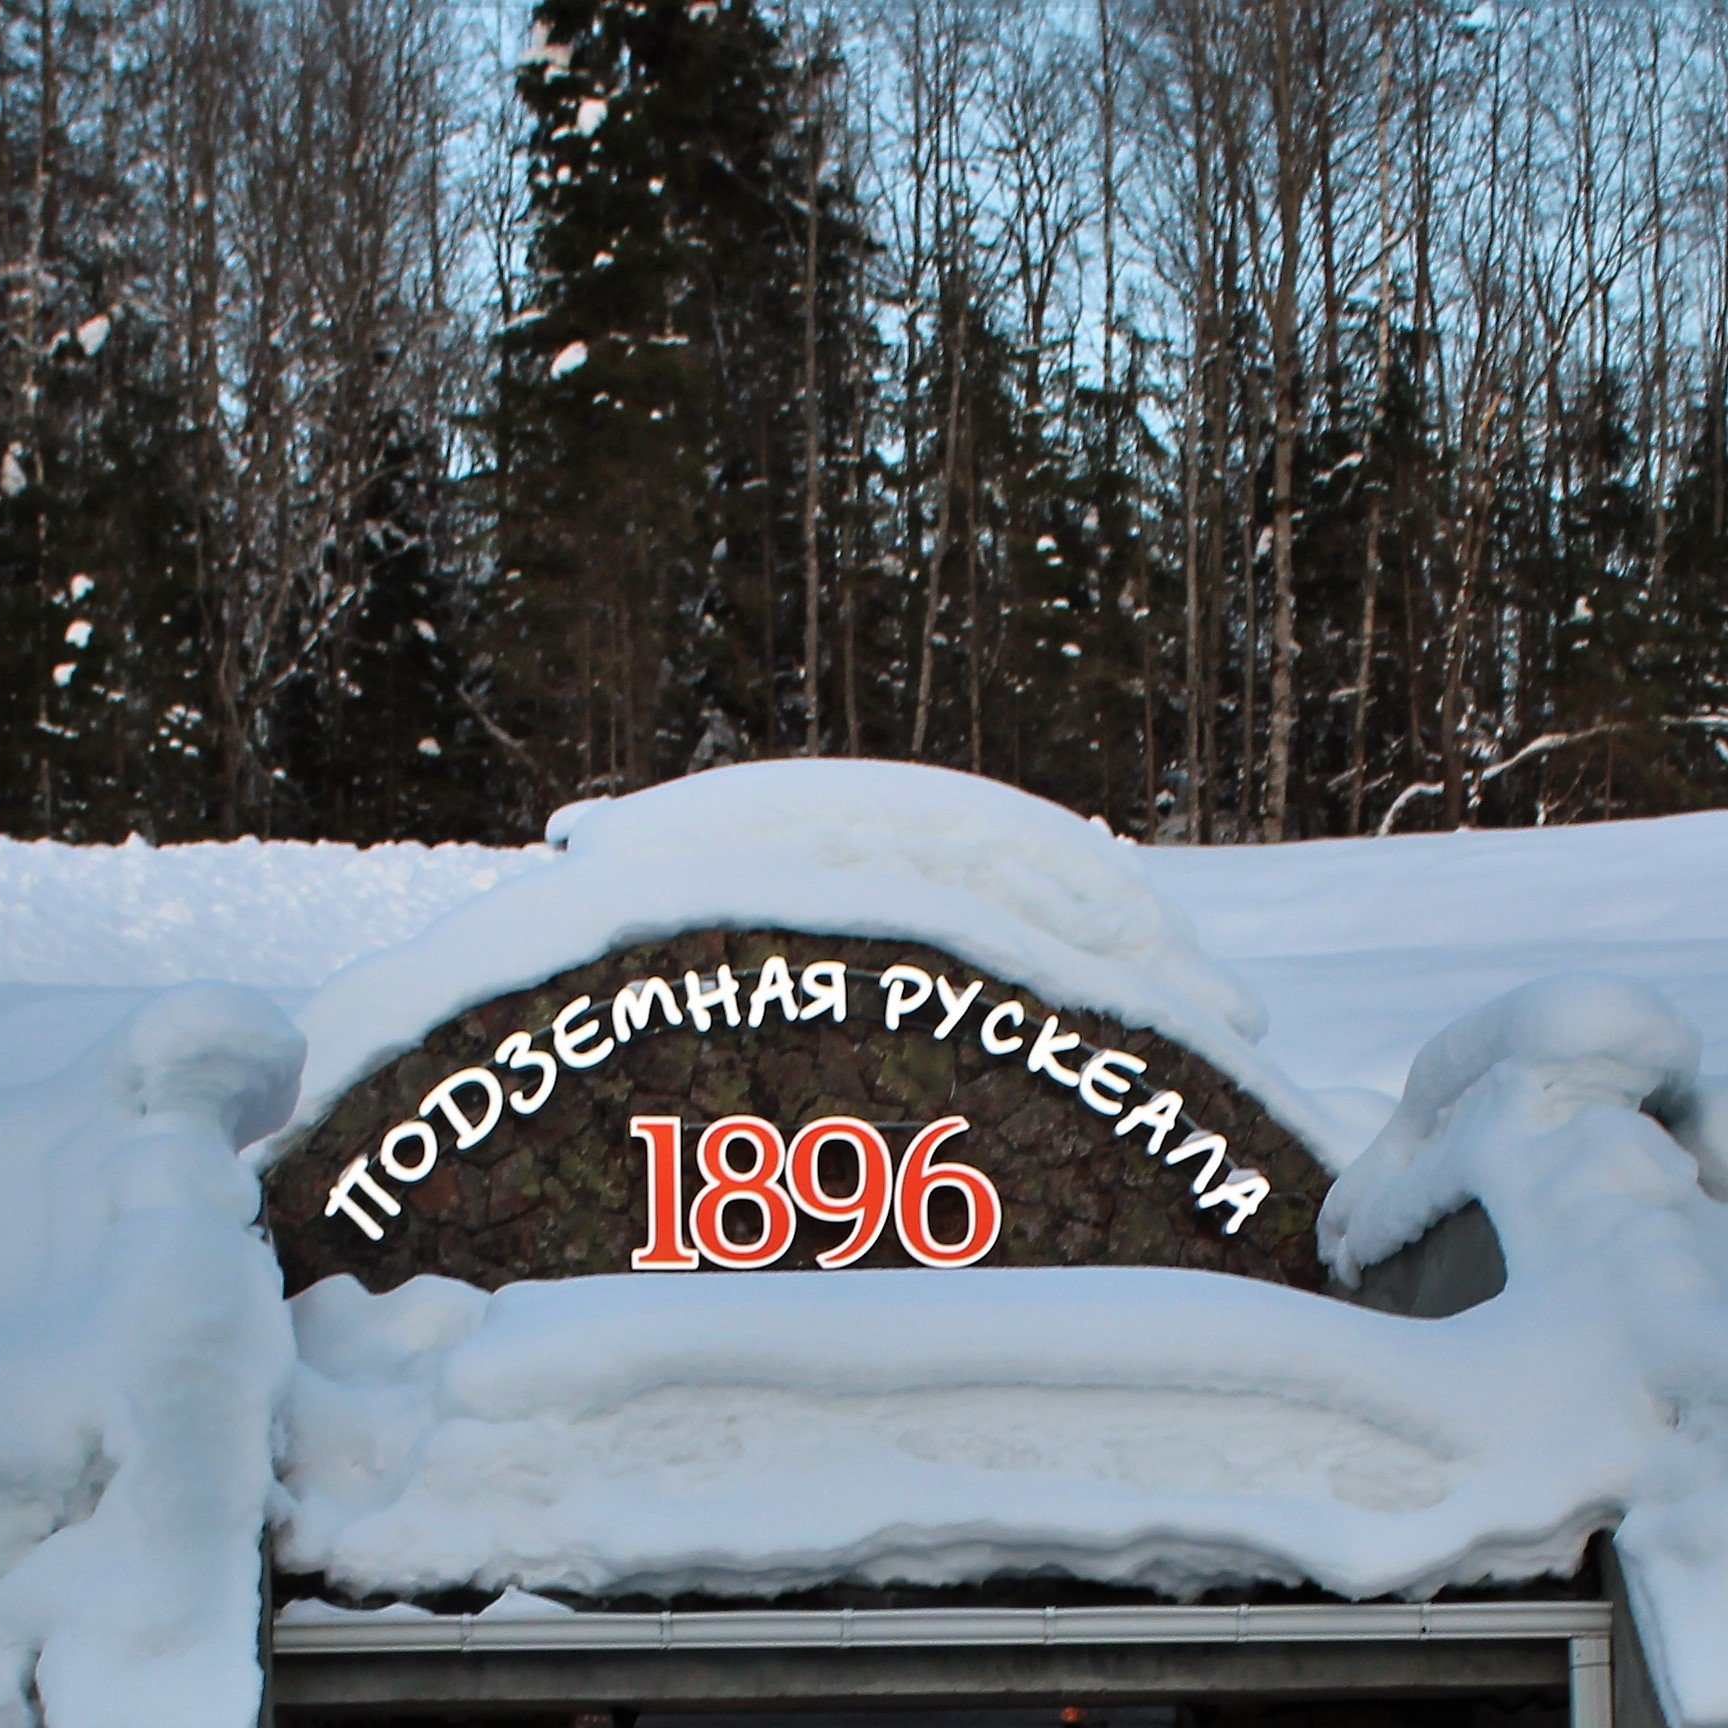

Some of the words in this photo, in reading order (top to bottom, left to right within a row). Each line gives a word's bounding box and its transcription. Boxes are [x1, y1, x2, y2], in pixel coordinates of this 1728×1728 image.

[323, 955, 848, 1242] ПОДЗЕМНАЯ
[878, 963, 1272, 1236] РУСКЕАЛА
[629, 1114, 1003, 1271] 1896
